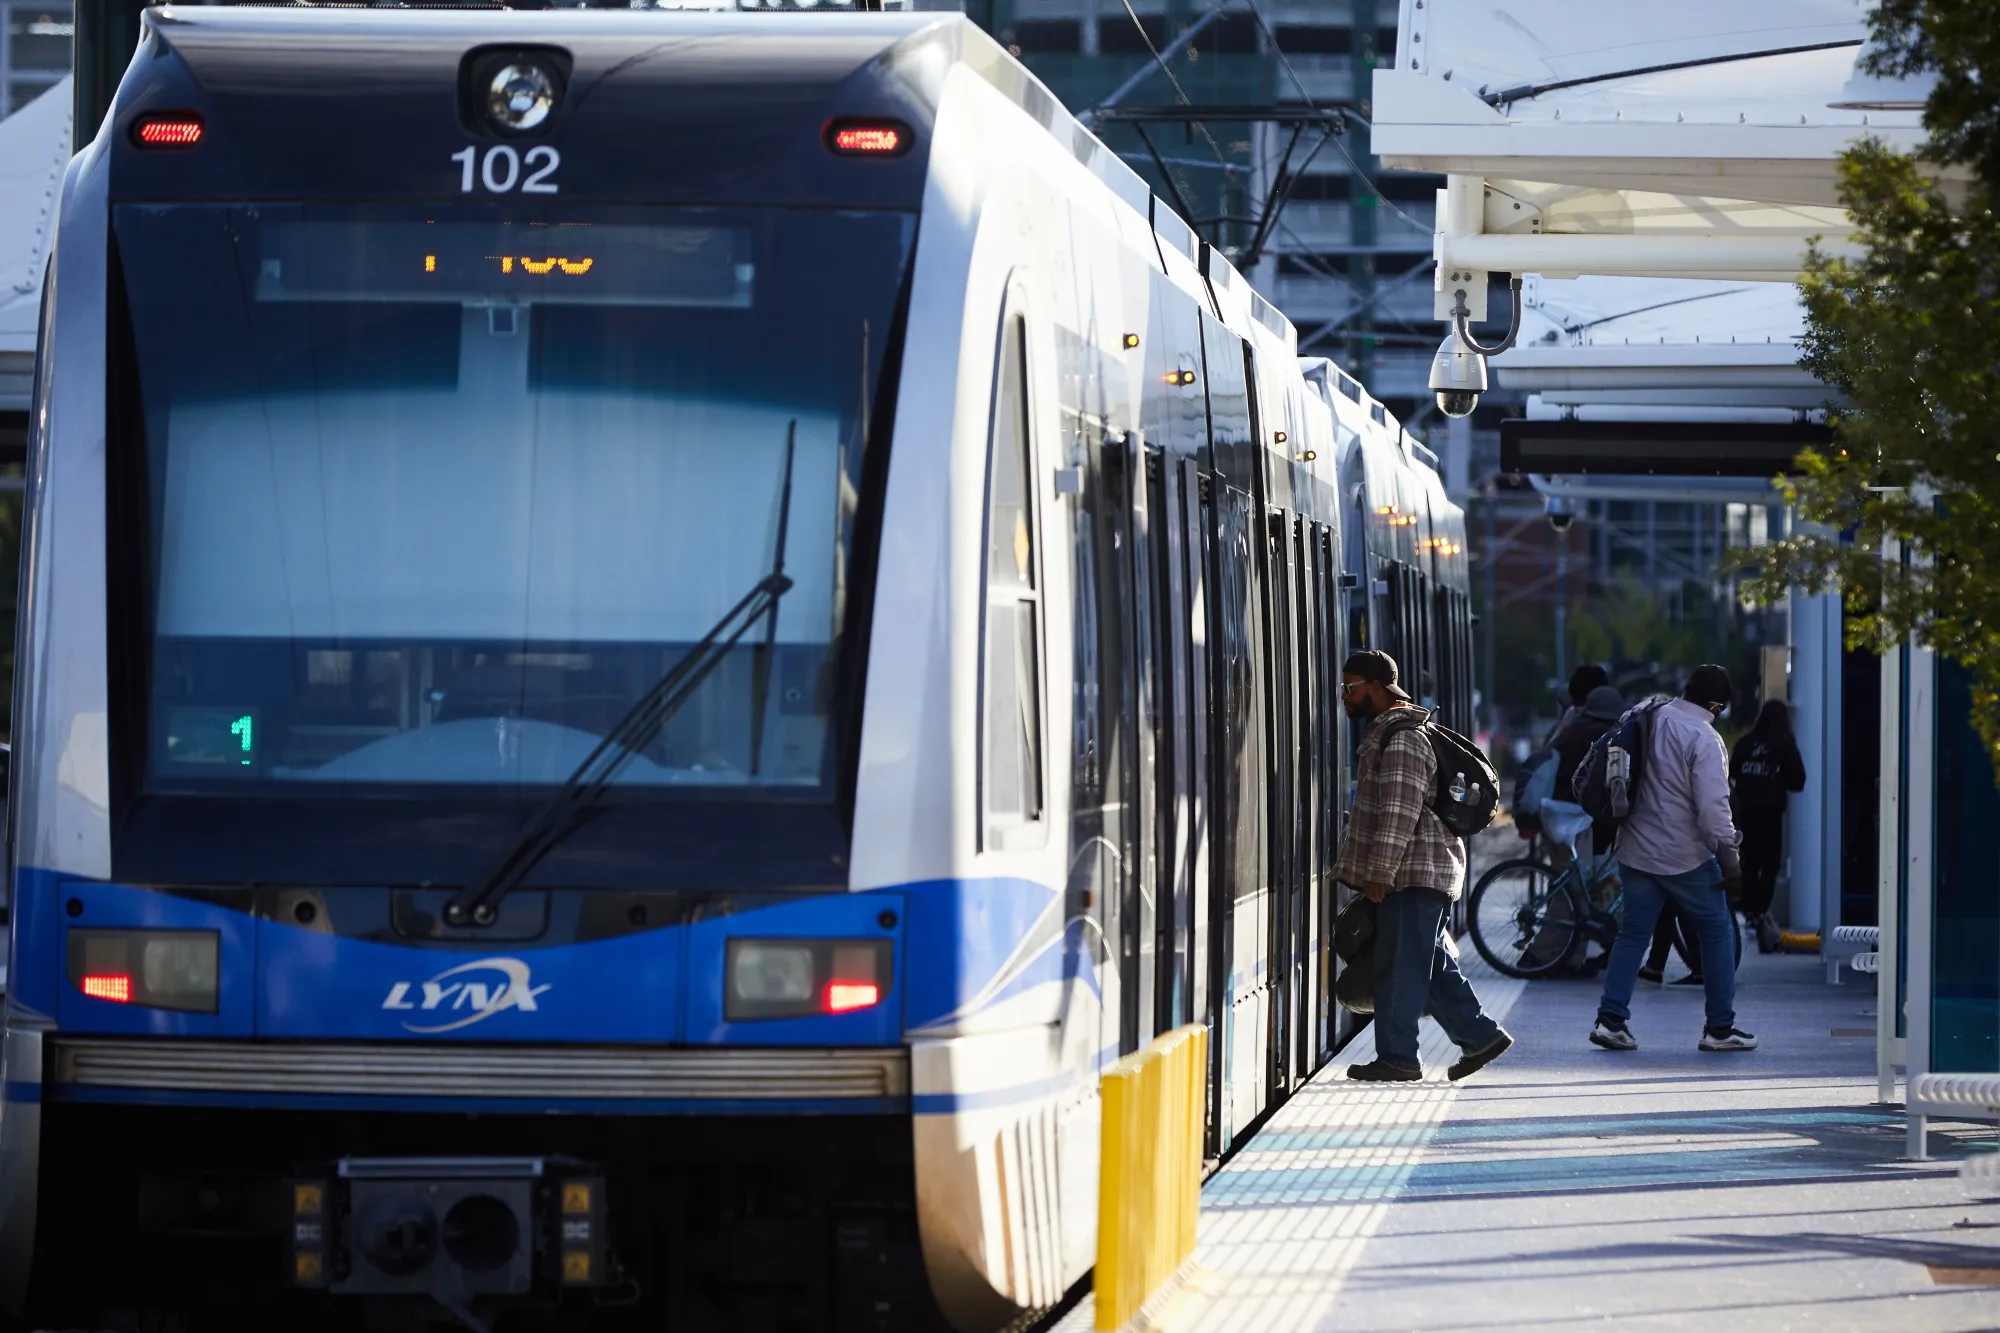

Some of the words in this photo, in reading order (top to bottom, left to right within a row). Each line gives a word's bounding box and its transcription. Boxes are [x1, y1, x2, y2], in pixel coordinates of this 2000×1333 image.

[451, 145, 561, 194] 102
[231, 715, 252, 752] 1
[381, 979, 552, 1012] LYNX
